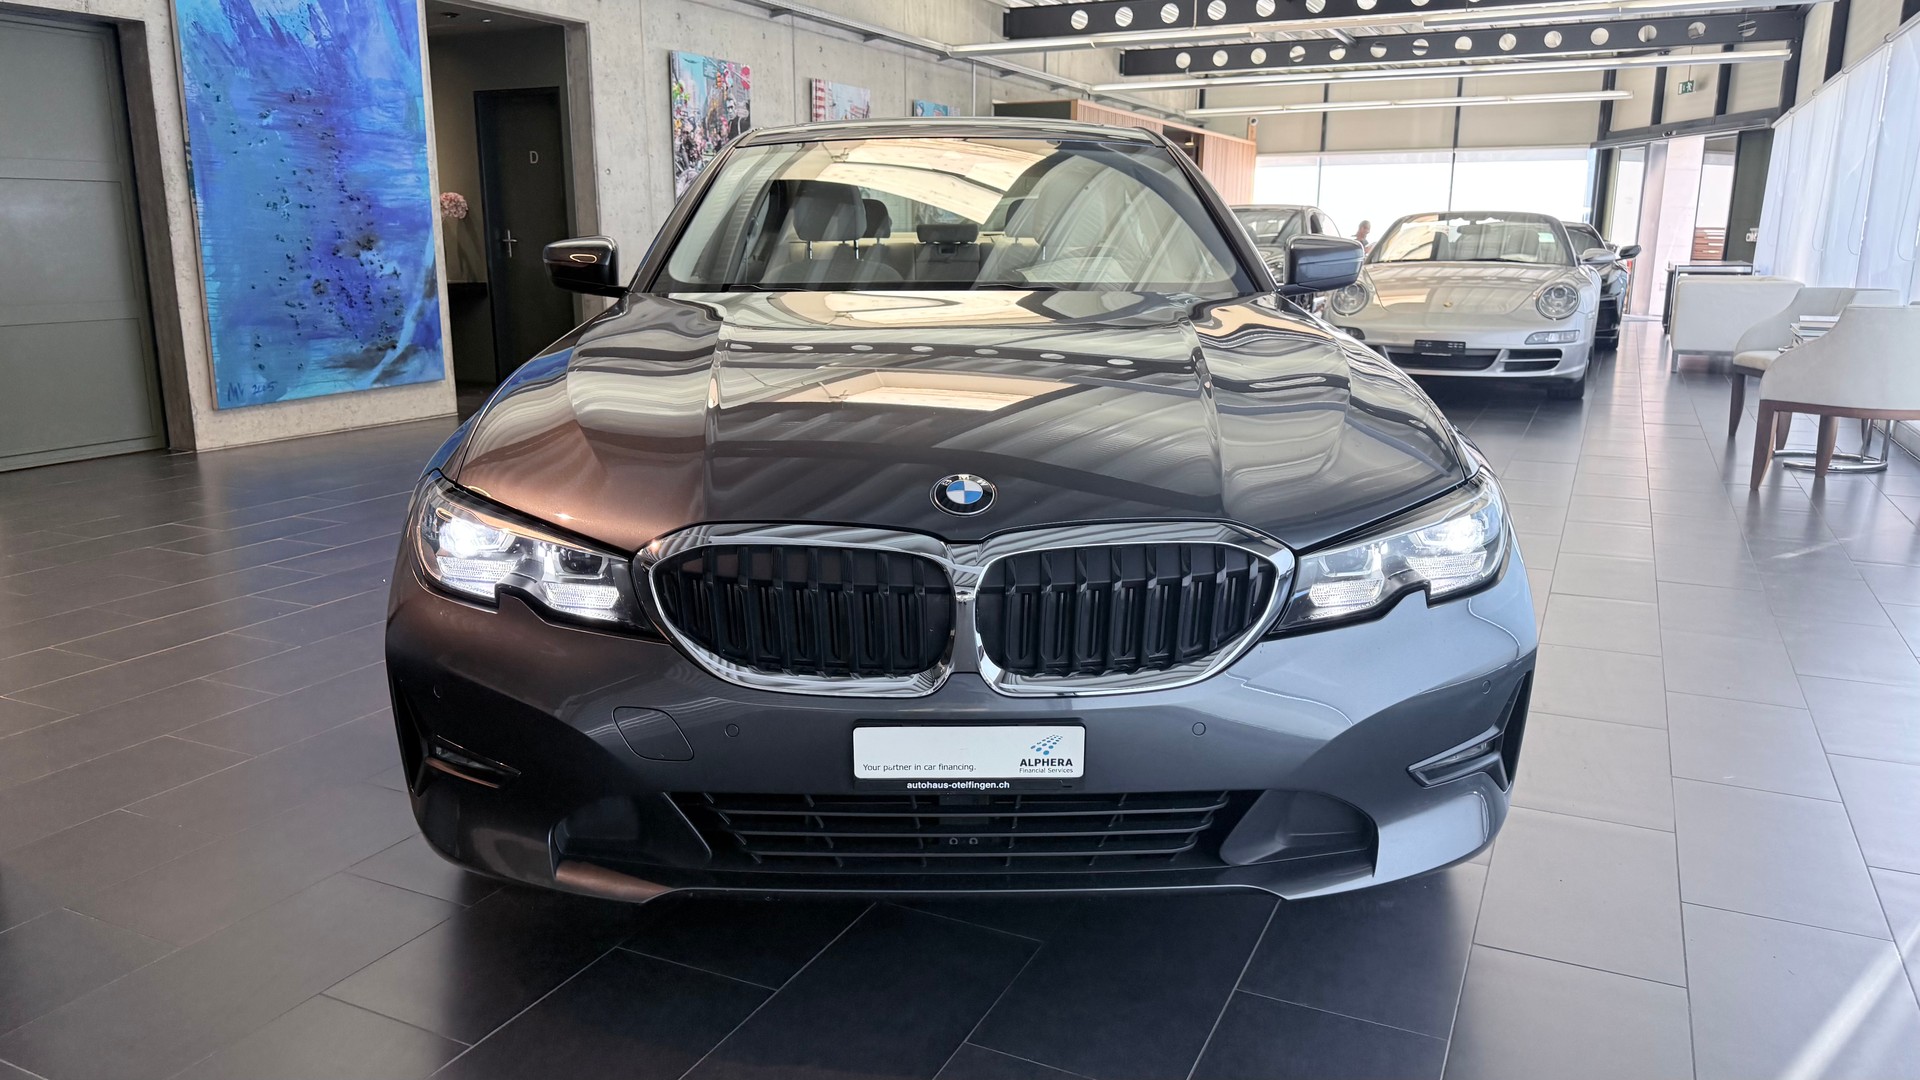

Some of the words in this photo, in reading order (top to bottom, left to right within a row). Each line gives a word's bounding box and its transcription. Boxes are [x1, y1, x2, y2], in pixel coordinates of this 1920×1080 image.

[529, 150, 539, 164] D
[940, 474, 989, 487] BMW
[1019, 758, 1073, 767] ALPHERA
[862, 763, 881, 771] Your
[883, 763, 911, 772] partner
[914, 763, 922, 771] in
[938, 763, 977, 773] financing.
[906, 781, 1010, 790] autohaus-otelfingen.ch
